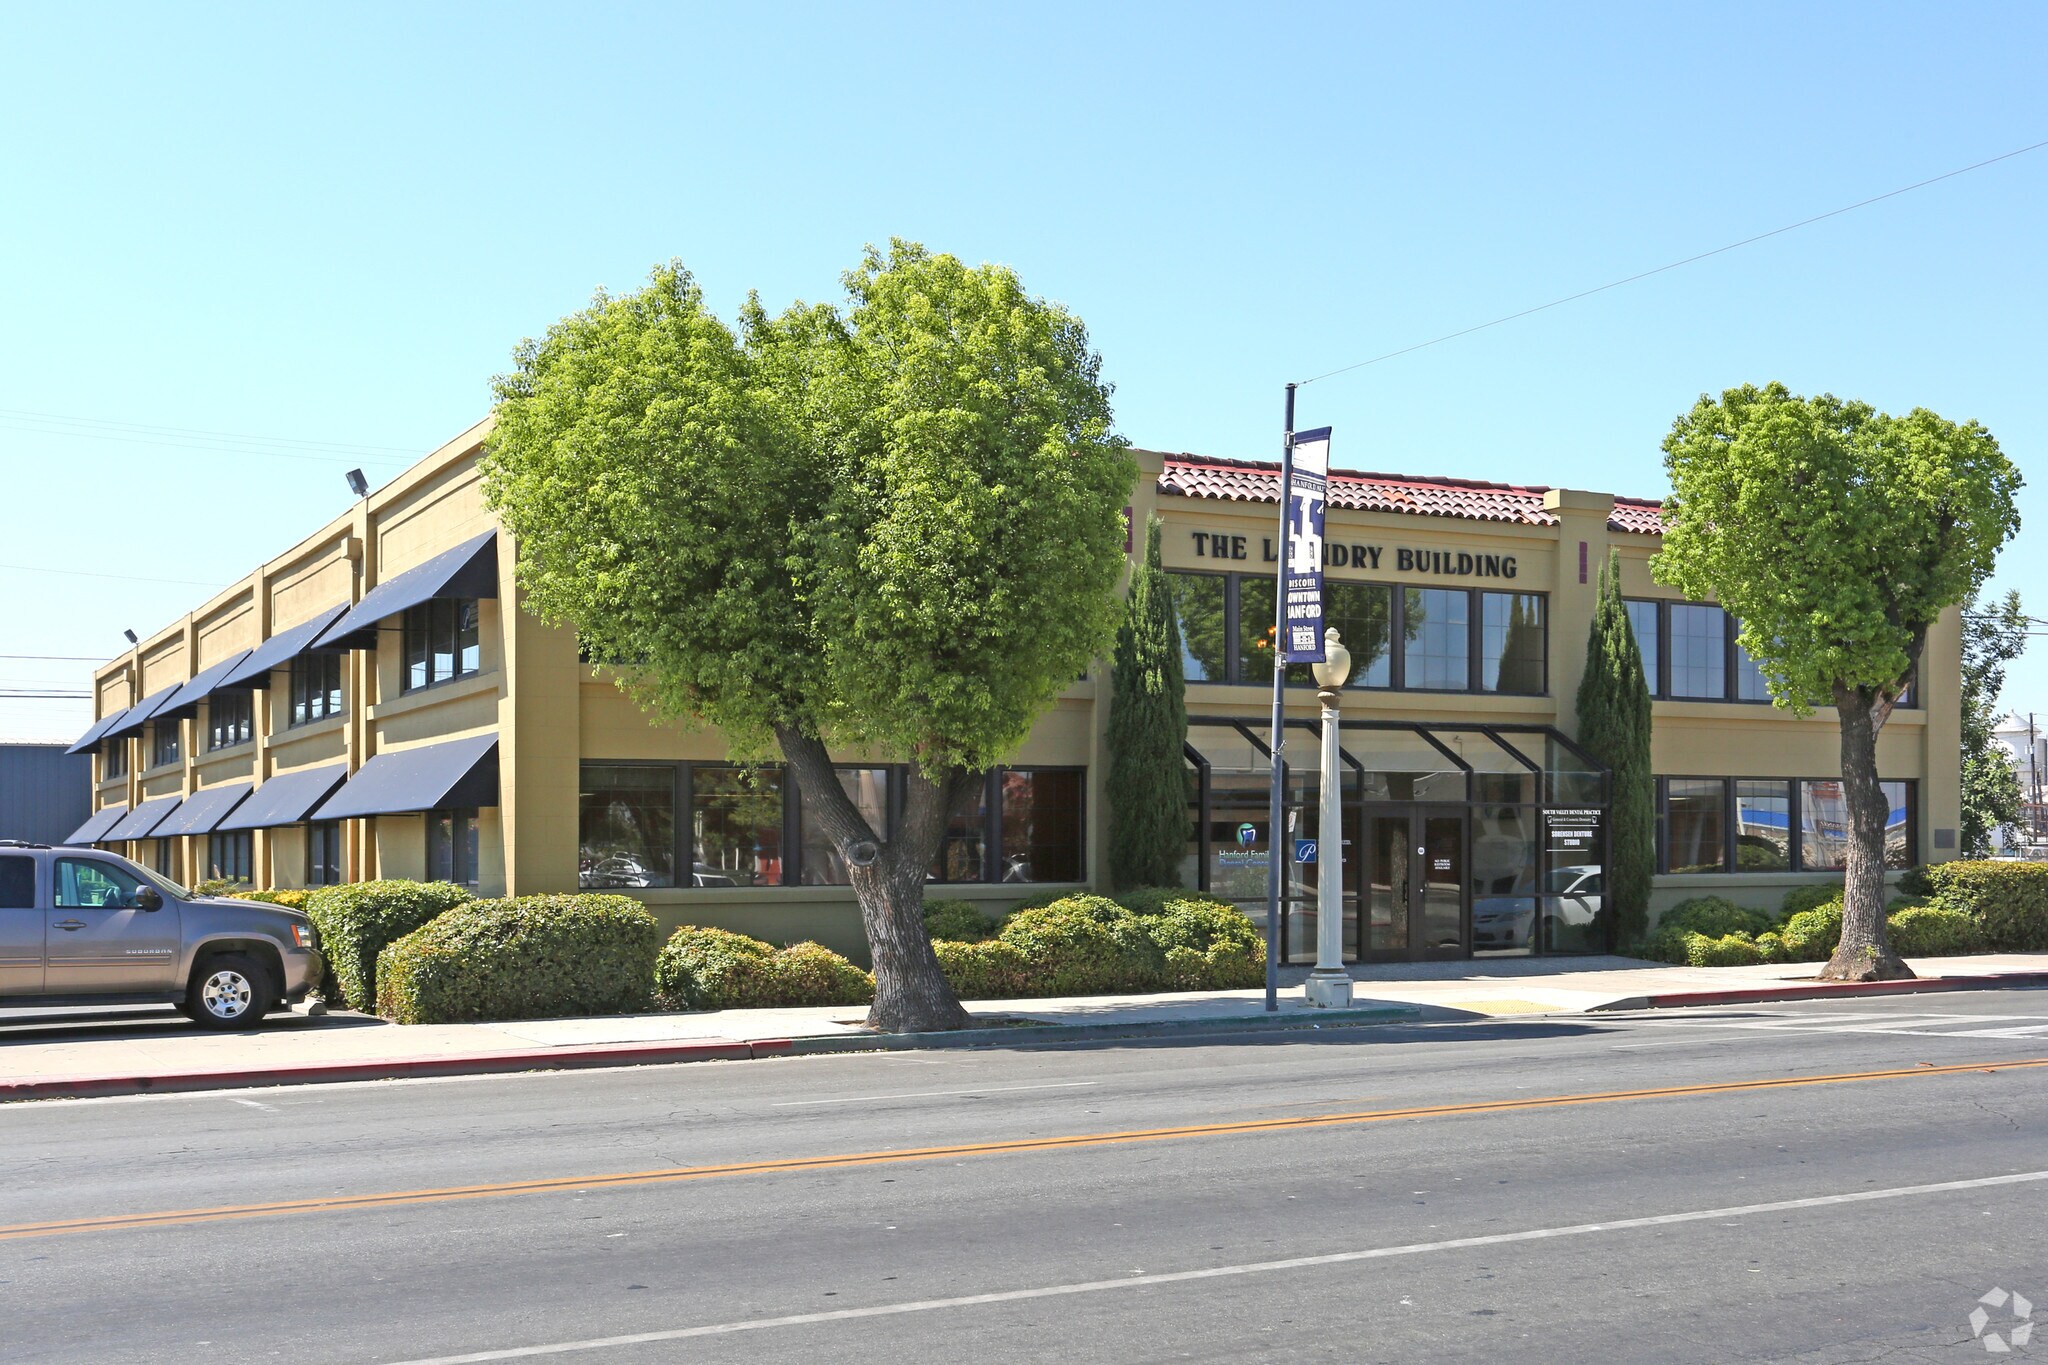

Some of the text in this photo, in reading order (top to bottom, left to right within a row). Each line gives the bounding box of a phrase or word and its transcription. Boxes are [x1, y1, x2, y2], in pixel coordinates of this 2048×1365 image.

[1192, 532, 1247, 560] THE
[1263, 538, 1383, 569] LDRY
[1397, 548, 1517, 579] BUILDING
[1287, 590, 1321, 604] OWNTOWN
[1219, 850, 1270, 858] Hanford Famil
